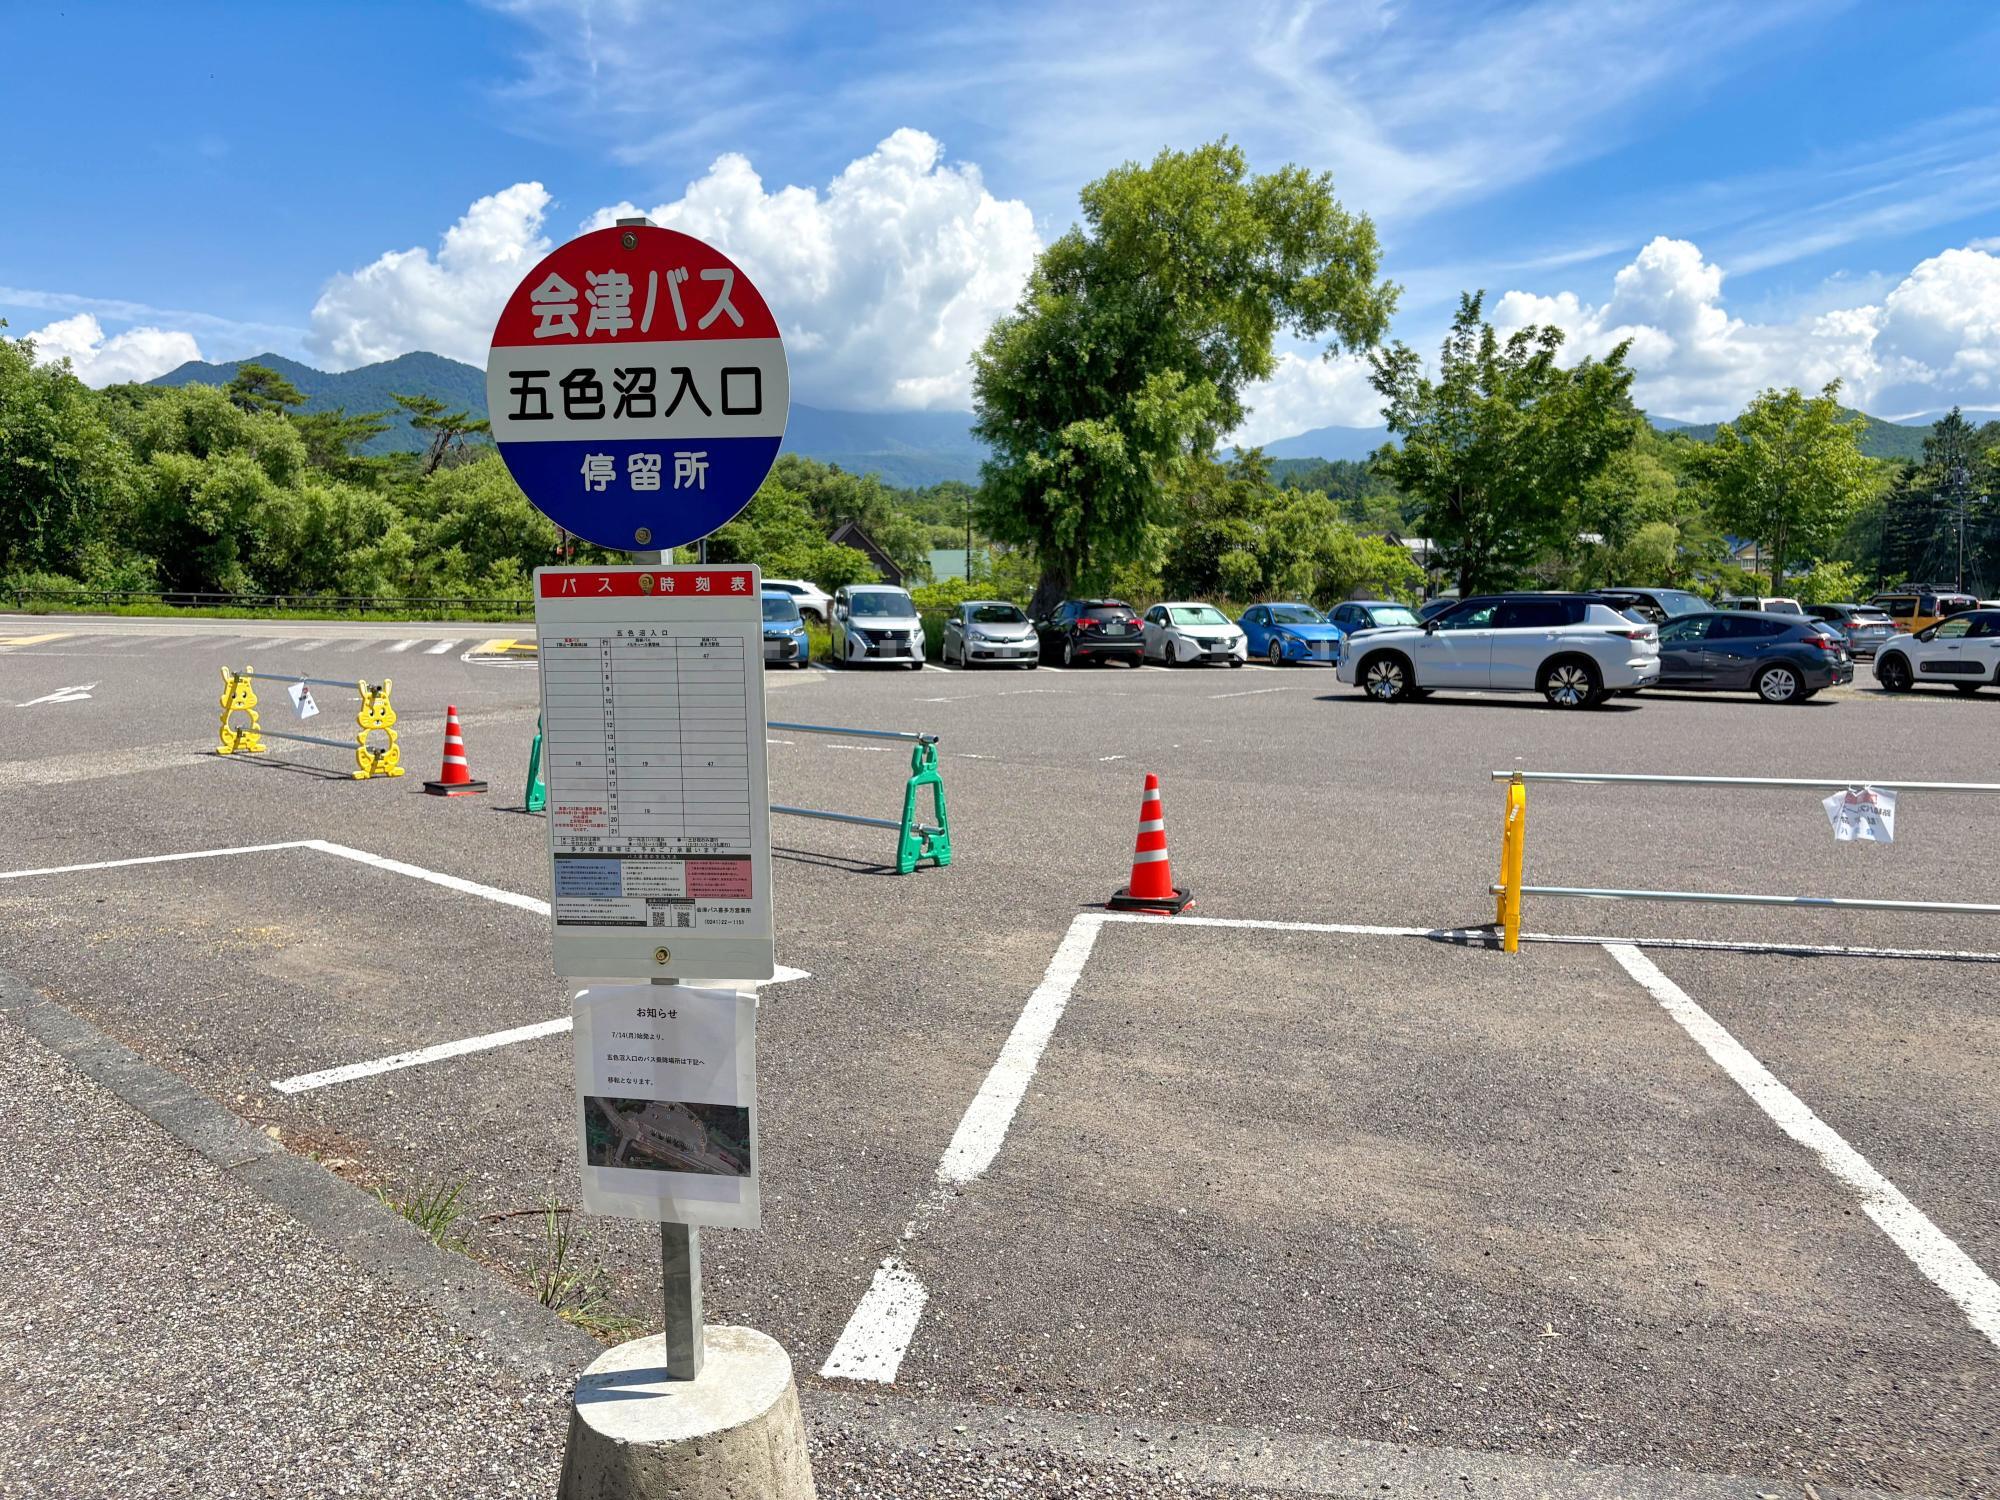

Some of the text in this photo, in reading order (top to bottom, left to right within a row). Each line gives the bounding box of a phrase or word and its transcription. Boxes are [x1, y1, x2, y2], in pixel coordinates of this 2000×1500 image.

[529, 266, 744, 338] 会津バス
[508, 366, 763, 421] 五色沼入口
[580, 451, 710, 492] 停留所
[616, 629, 669, 637] 五色沼入口
[636, 1007, 678, 1019] お知らせ
